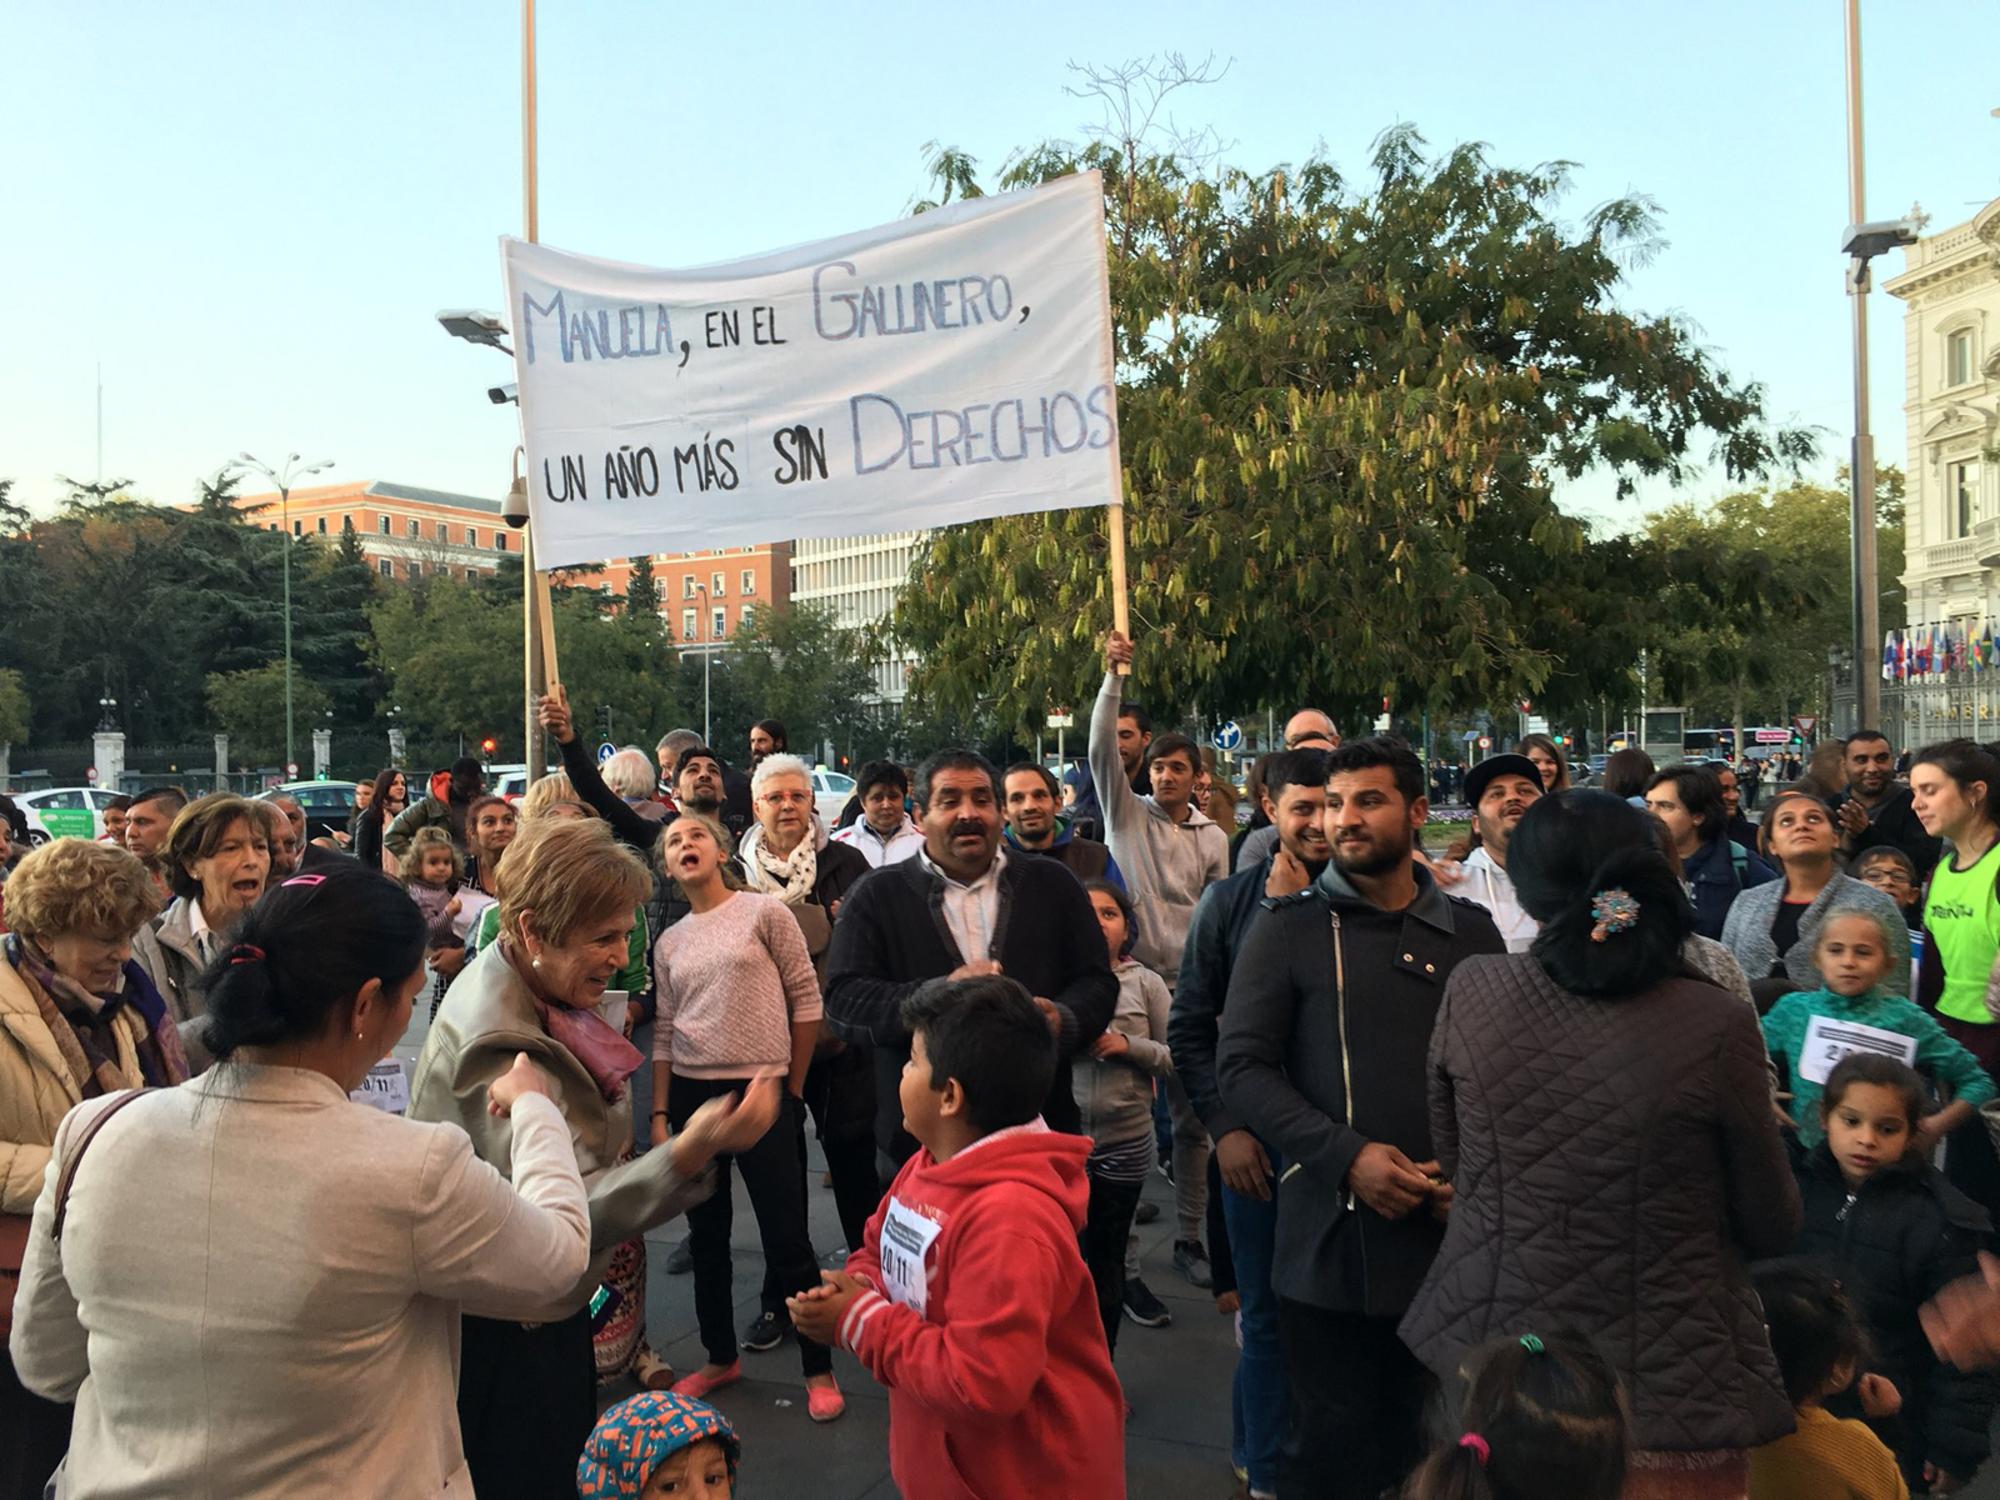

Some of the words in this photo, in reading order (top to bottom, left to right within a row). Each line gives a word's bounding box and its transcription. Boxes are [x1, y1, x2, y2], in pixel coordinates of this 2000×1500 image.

[705, 308, 741, 349] EN
[752, 306, 788, 346] EL
[545, 454, 587, 503] UN
[605, 445, 659, 500] AÑO
[674, 430, 739, 494] MÁS
[773, 424, 829, 485] SIN
[850, 384, 1116, 475] DERECHOS
